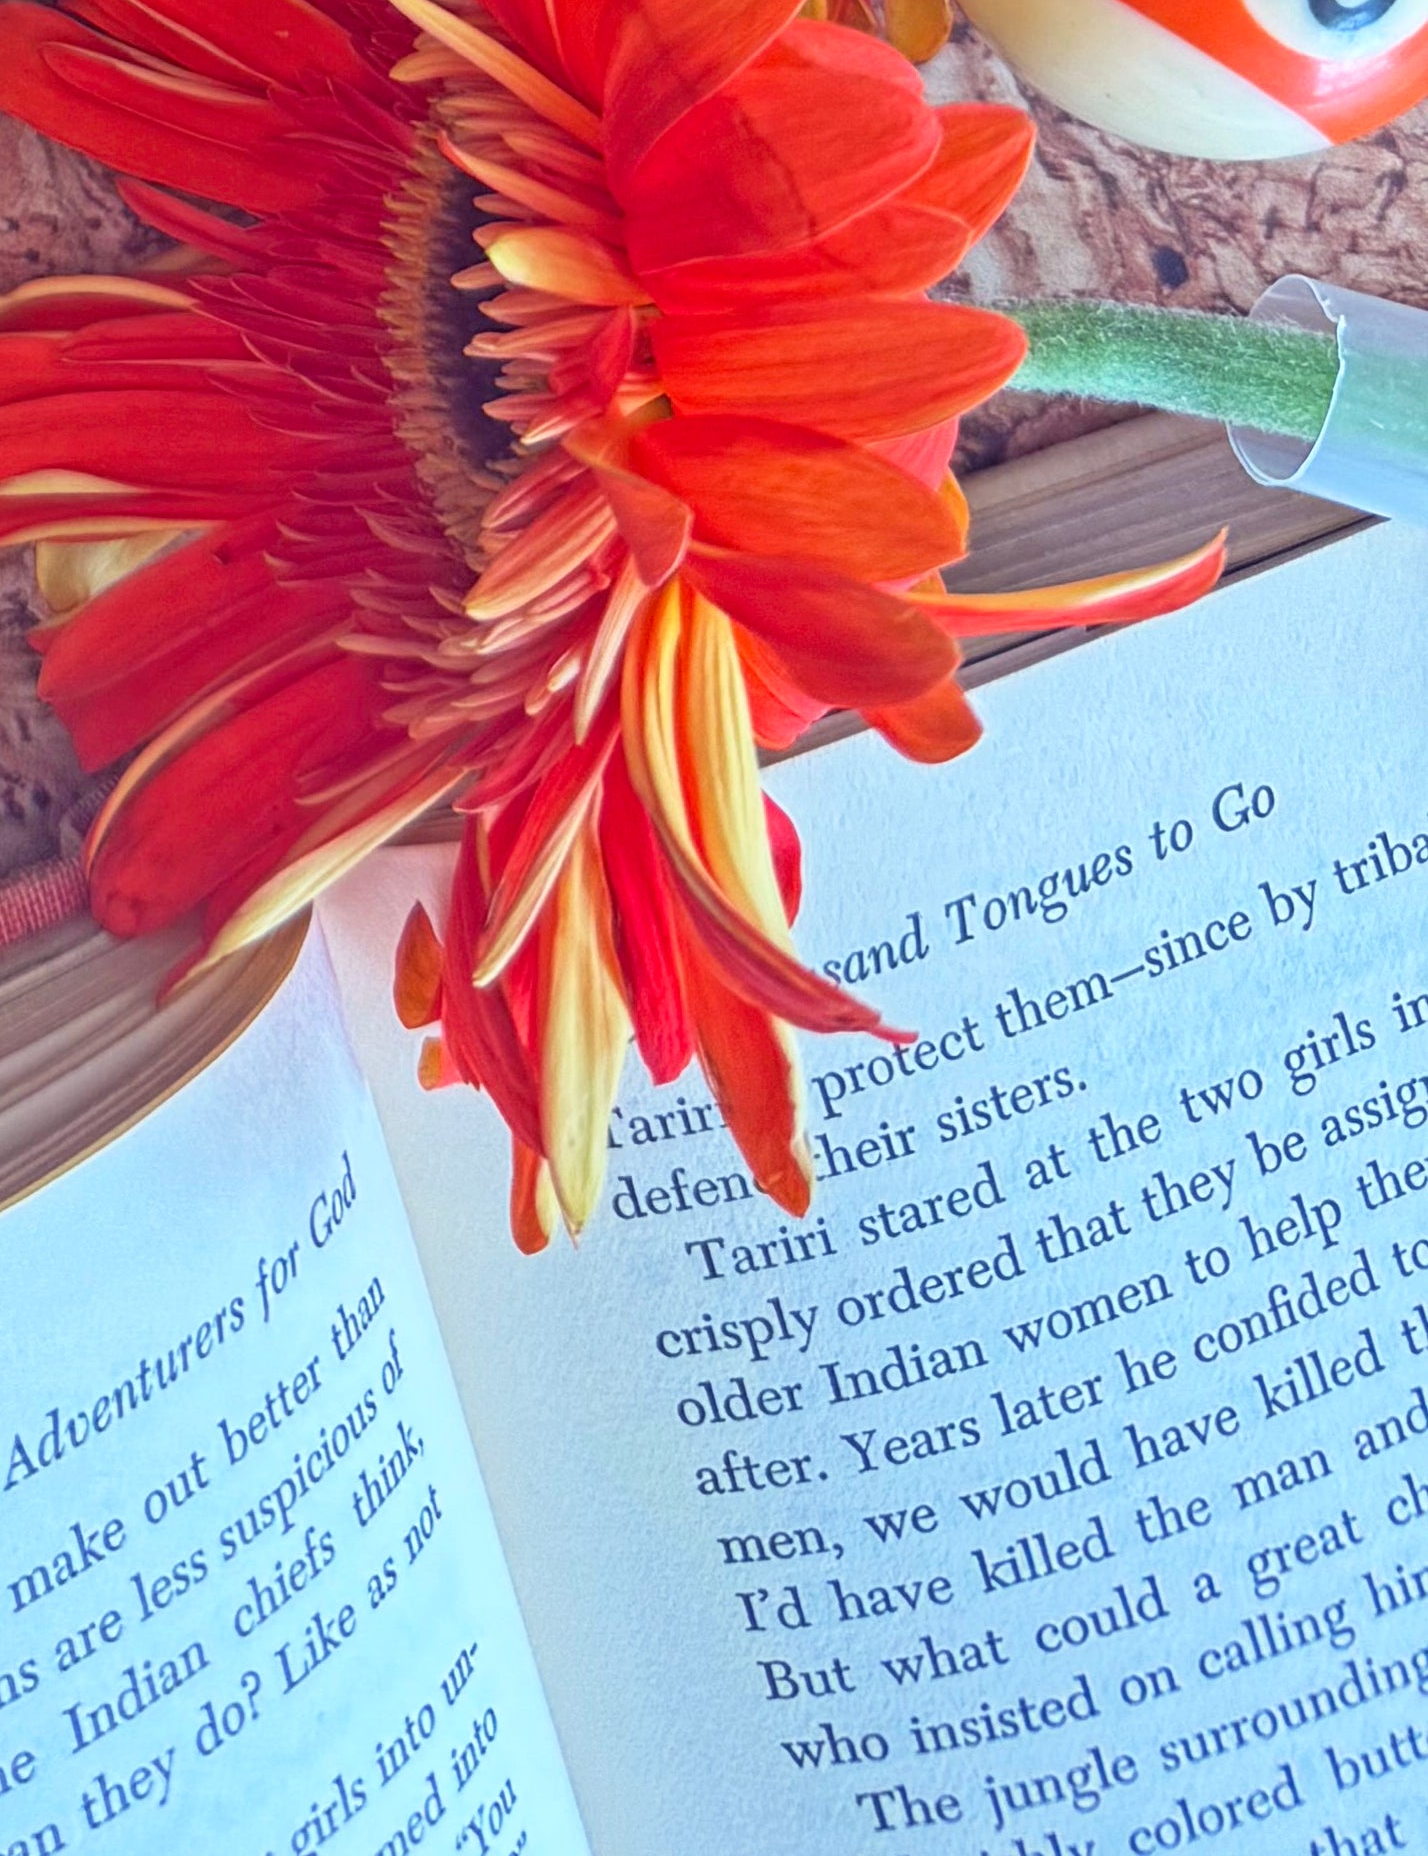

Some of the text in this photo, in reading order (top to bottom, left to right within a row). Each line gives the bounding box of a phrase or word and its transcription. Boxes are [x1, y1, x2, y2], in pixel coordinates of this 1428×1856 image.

[810, 782, 1275, 985] sand Tongues to Go
[812, 1018, 985, 1120] protect
[1258, 879, 1317, 931] by
[1333, 831, 1428, 895] triba
[612, 1168, 768, 1220] defen
[937, 1067, 1087, 1143] sisters.
[656, 1076, 1428, 1362] crisply ordered that they be assig
[684, 1217, 838, 1281] Tariri
[859, 1160, 1007, 1246] stared
[1026, 1144, 1071, 1190] at
[1088, 1112, 1161, 1162] the
[1180, 1069, 1263, 1123] two
[1284, 1011, 1376, 1097] girls
[3, 1150, 357, 1492] Adventurers for God
[677, 1160, 1428, 1427] older Indian women to help the
[696, 1450, 828, 1496] after.
[839, 1417, 981, 1474] Years
[990, 1375, 1103, 1437] later
[1114, 1349, 1177, 1394] he
[1194, 1248, 1381, 1363] confided
[7, 1519, 126, 1613] make
[144, 1451, 210, 1525] out
[217, 1355, 322, 1466] better
[331, 1277, 385, 1361] than
[55, 1610, 123, 1673] are
[130, 1549, 208, 1622] less
[219, 1388, 378, 1562] suspicious
[381, 1328, 405, 1396] of
[716, 1527, 844, 1564] men,
[862, 1504, 938, 1543] we
[958, 1438, 1112, 1520] would
[1123, 1406, 1240, 1469] have
[1252, 1327, 1386, 1420] killed
[826, 1576, 954, 1622] have
[970, 1515, 1116, 1594] killed
[1136, 1495, 1212, 1544] the
[1231, 1450, 1333, 1511] man
[62, 1642, 210, 1755] Indian
[234, 1526, 335, 1638] chiefs
[353, 1420, 424, 1528] think,
[81, 1747, 175, 1830] they
[196, 1670, 261, 1756] do?
[274, 1605, 356, 1695] Like
[367, 1556, 398, 1610] as
[404, 1484, 443, 1565] not
[756, 1658, 857, 1701] But
[880, 1630, 1010, 1686] what
[1035, 1574, 1170, 1654] could
[1193, 1572, 1222, 1604] a
[1247, 1510, 1364, 1600] great
[780, 1723, 889, 1769] who
[910, 1674, 1101, 1755] insisted
[1120, 1666, 1181, 1706] on
[1198, 1598, 1356, 1680] calling
[375, 1704, 436, 1788] into
[441, 1642, 478, 1706] un-
[451, 1707, 497, 1792] into
[855, 1784, 963, 1833] The
[984, 1746, 1138, 1832] jungle
[1129, 1762, 1305, 1856] colored
